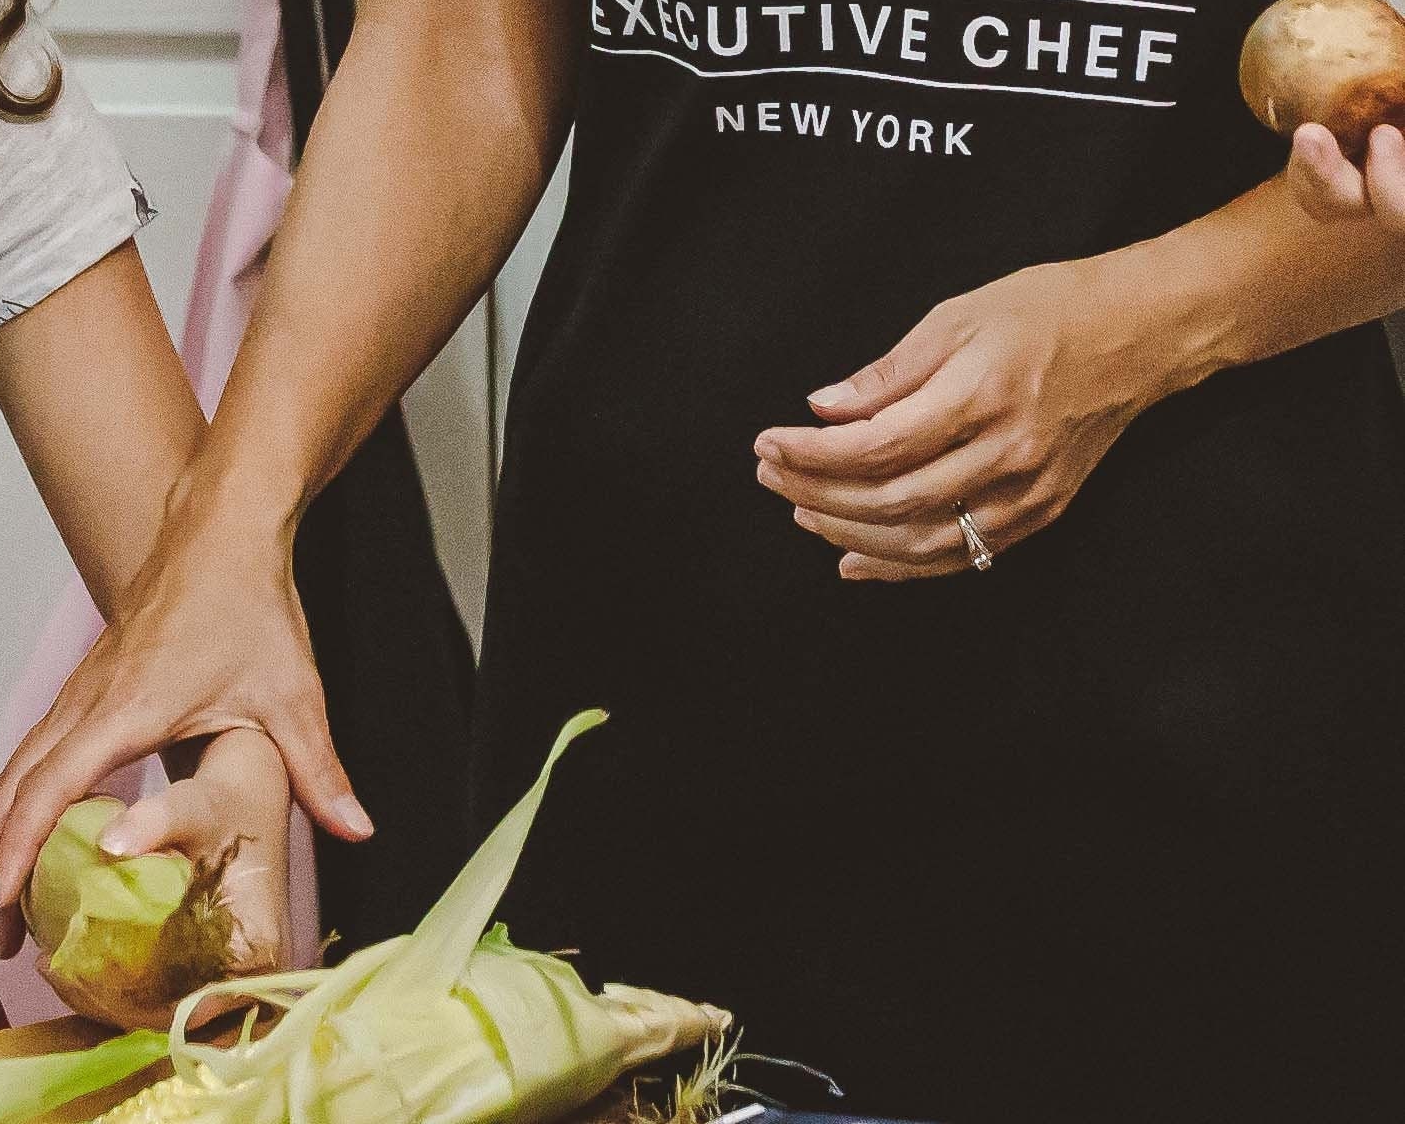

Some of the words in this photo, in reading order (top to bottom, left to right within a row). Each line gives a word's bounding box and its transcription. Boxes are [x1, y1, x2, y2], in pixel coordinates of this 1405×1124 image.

[962, 15, 1178, 82] CHEF
[715, 102, 831, 137] NEW
[851, 109, 974, 156] YORK
